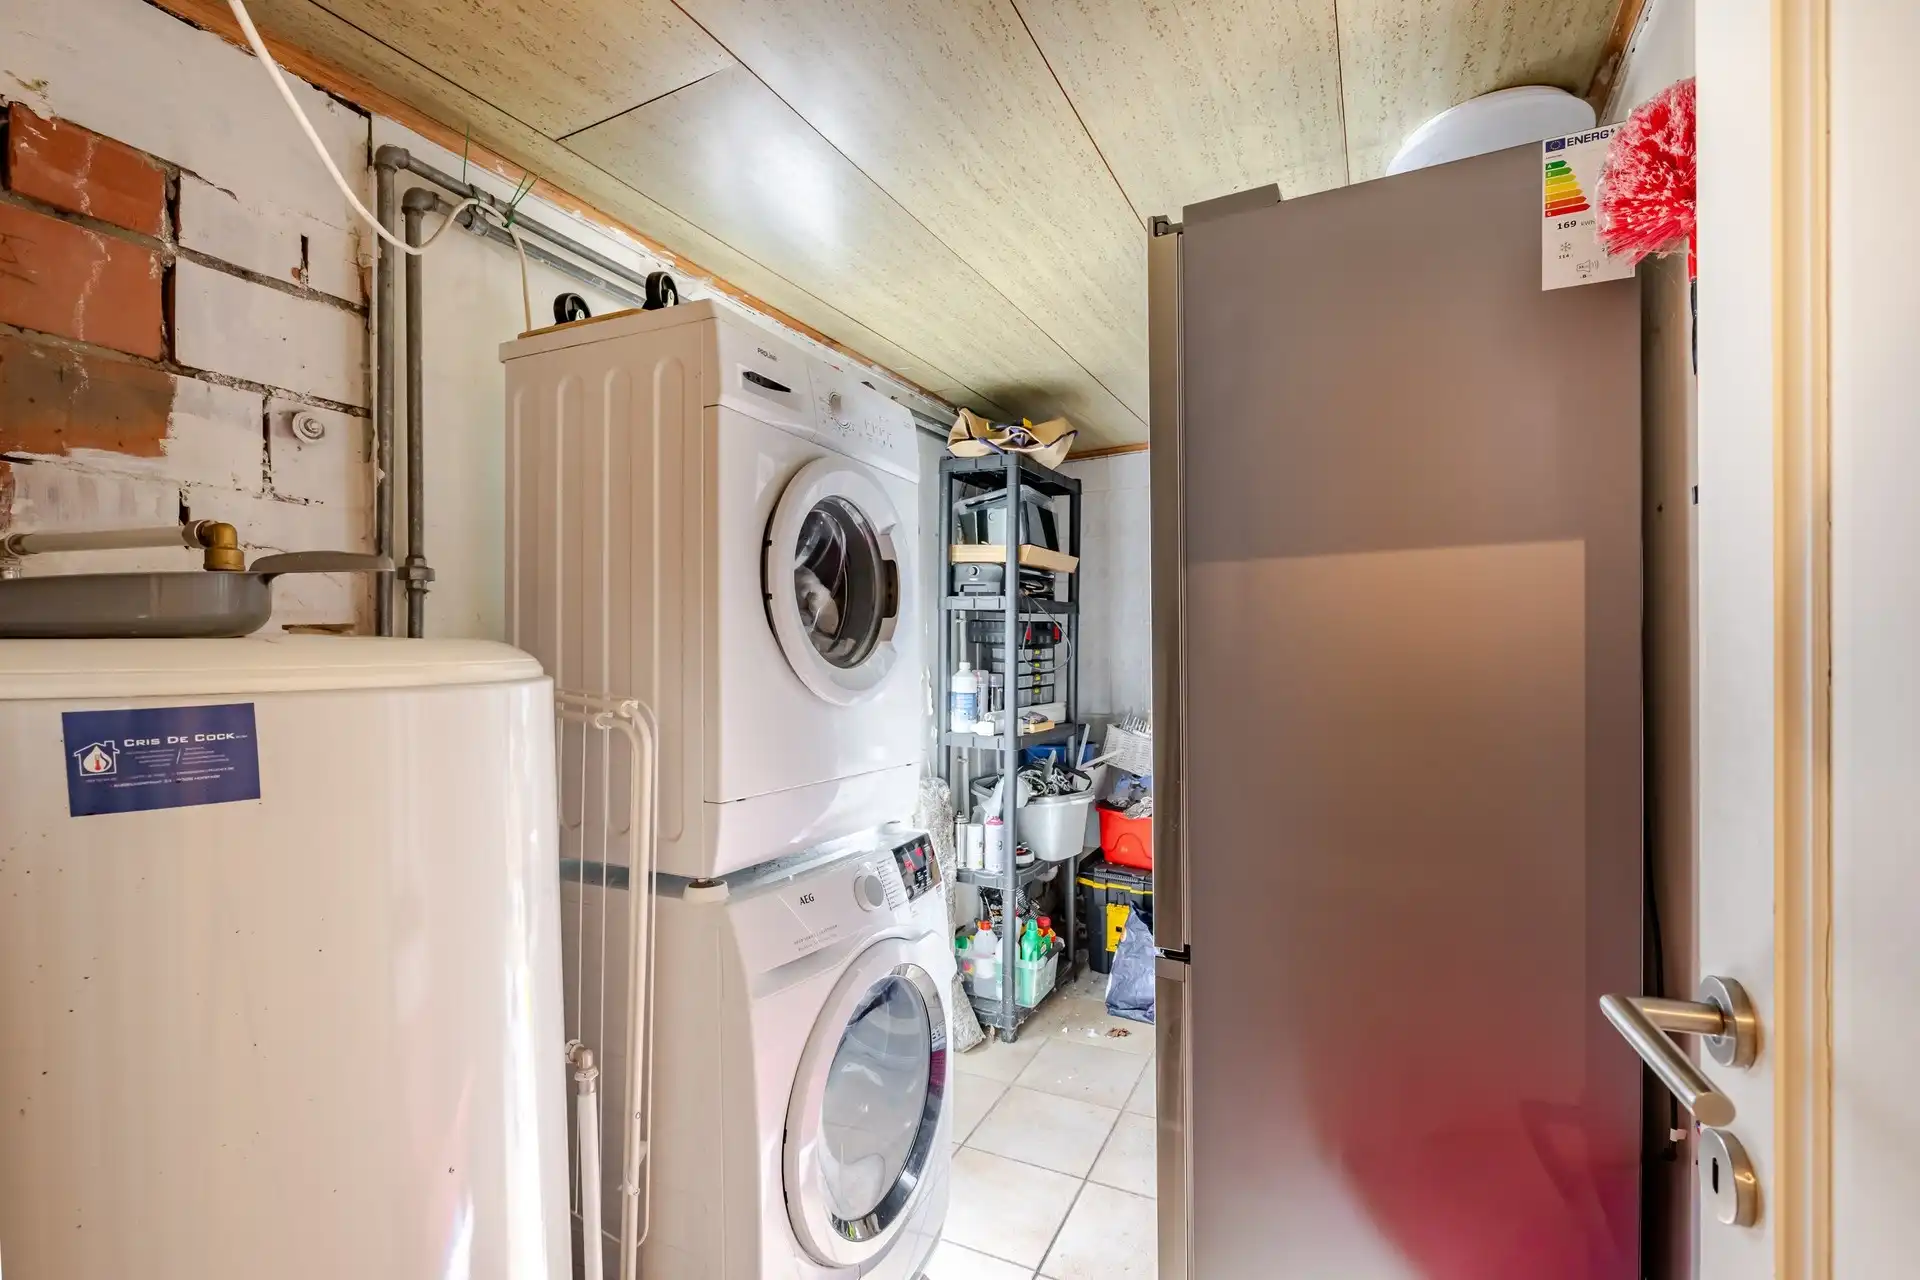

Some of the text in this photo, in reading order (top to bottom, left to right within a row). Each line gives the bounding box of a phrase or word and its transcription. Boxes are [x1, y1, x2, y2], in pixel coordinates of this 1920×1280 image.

[1567, 129, 1609, 147] ENERG
[1557, 220, 1577, 230] 169
[800, 893, 814, 906] AEG
